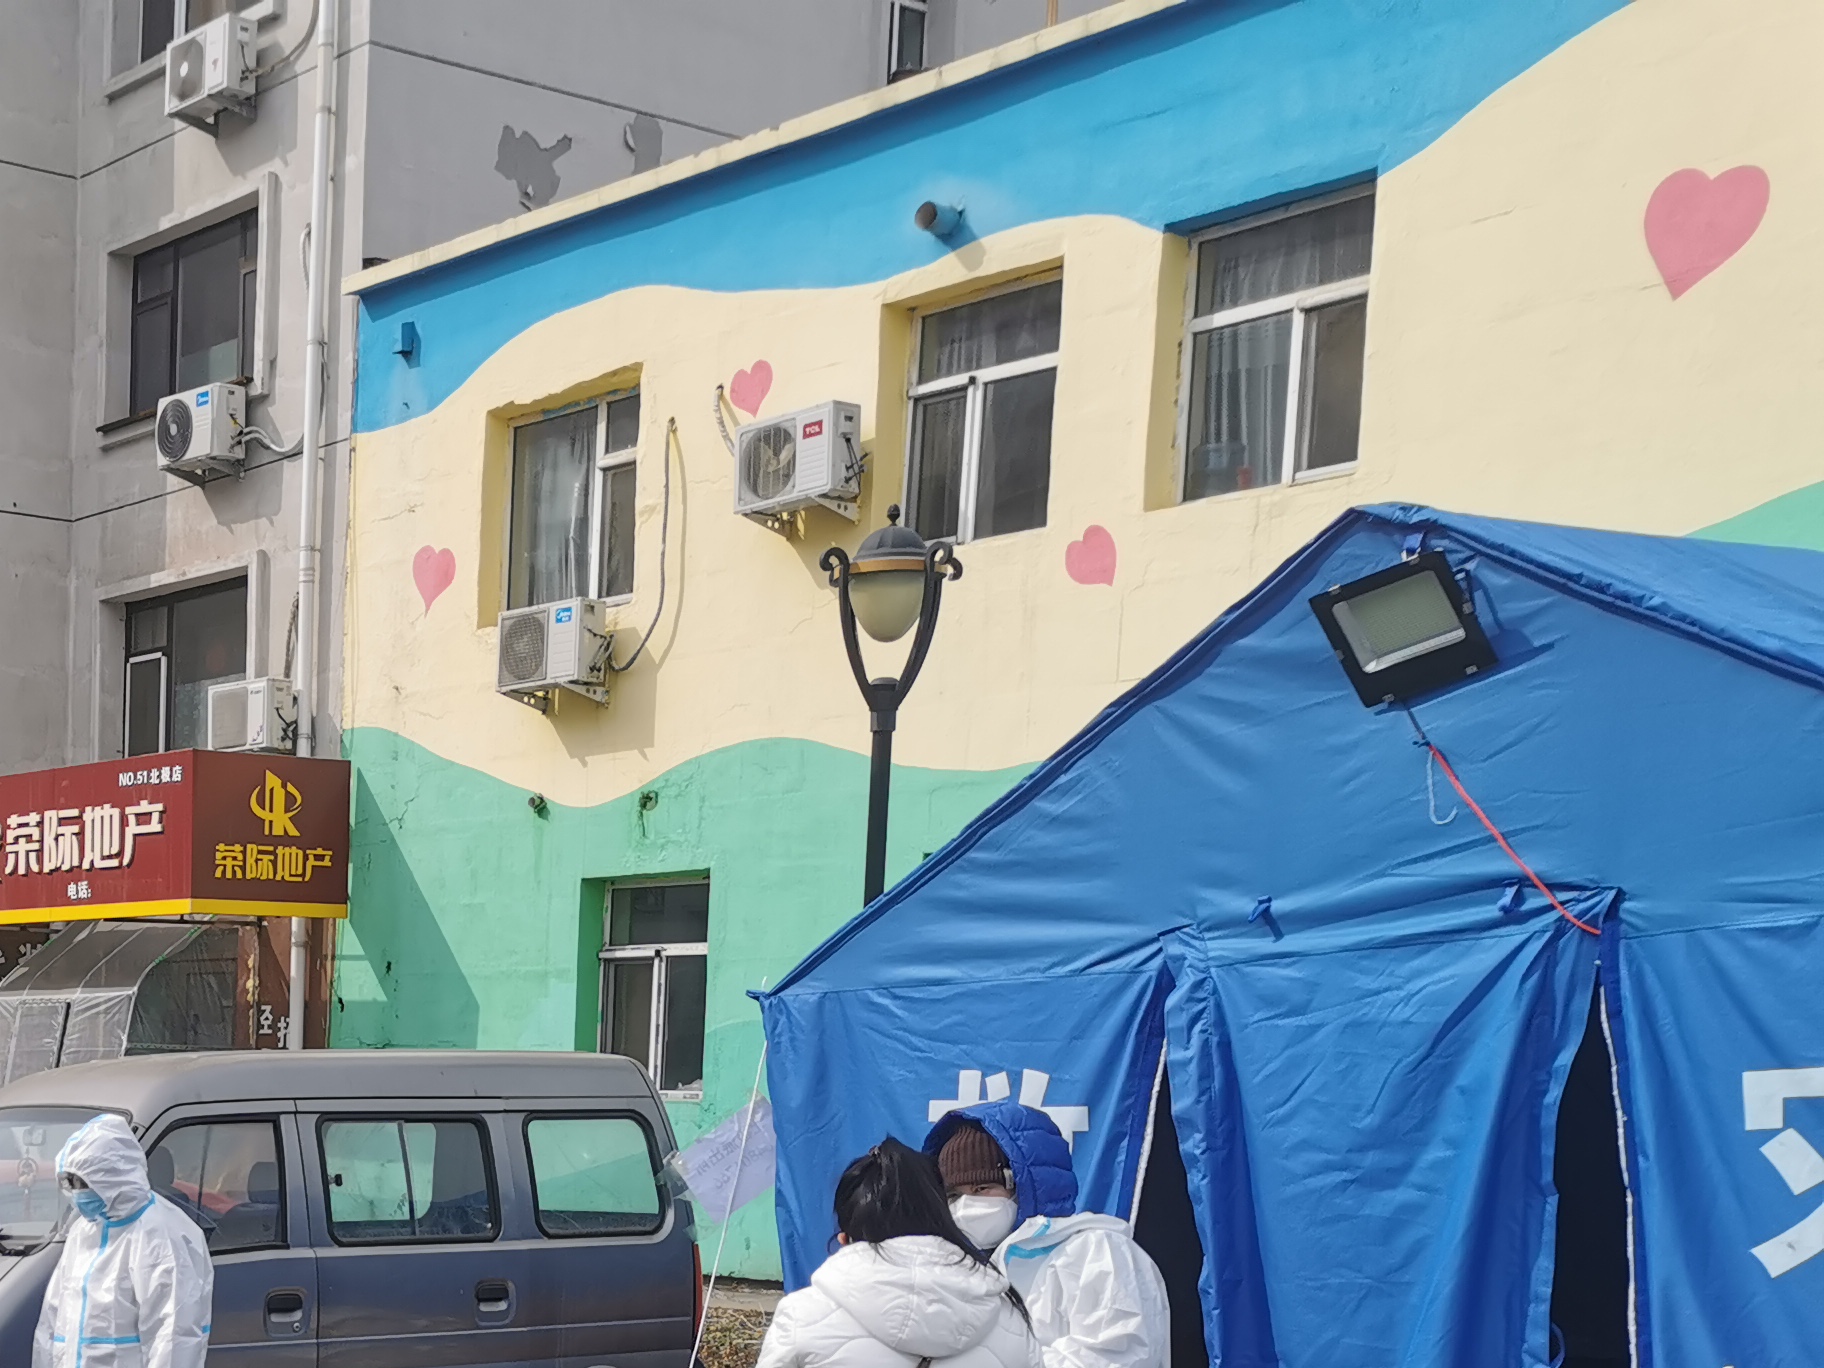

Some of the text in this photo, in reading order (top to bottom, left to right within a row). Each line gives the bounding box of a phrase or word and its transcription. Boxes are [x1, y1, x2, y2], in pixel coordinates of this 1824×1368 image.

[4, 799, 166, 876] 荣际地产
[214, 843, 333, 883] 荣际地产
